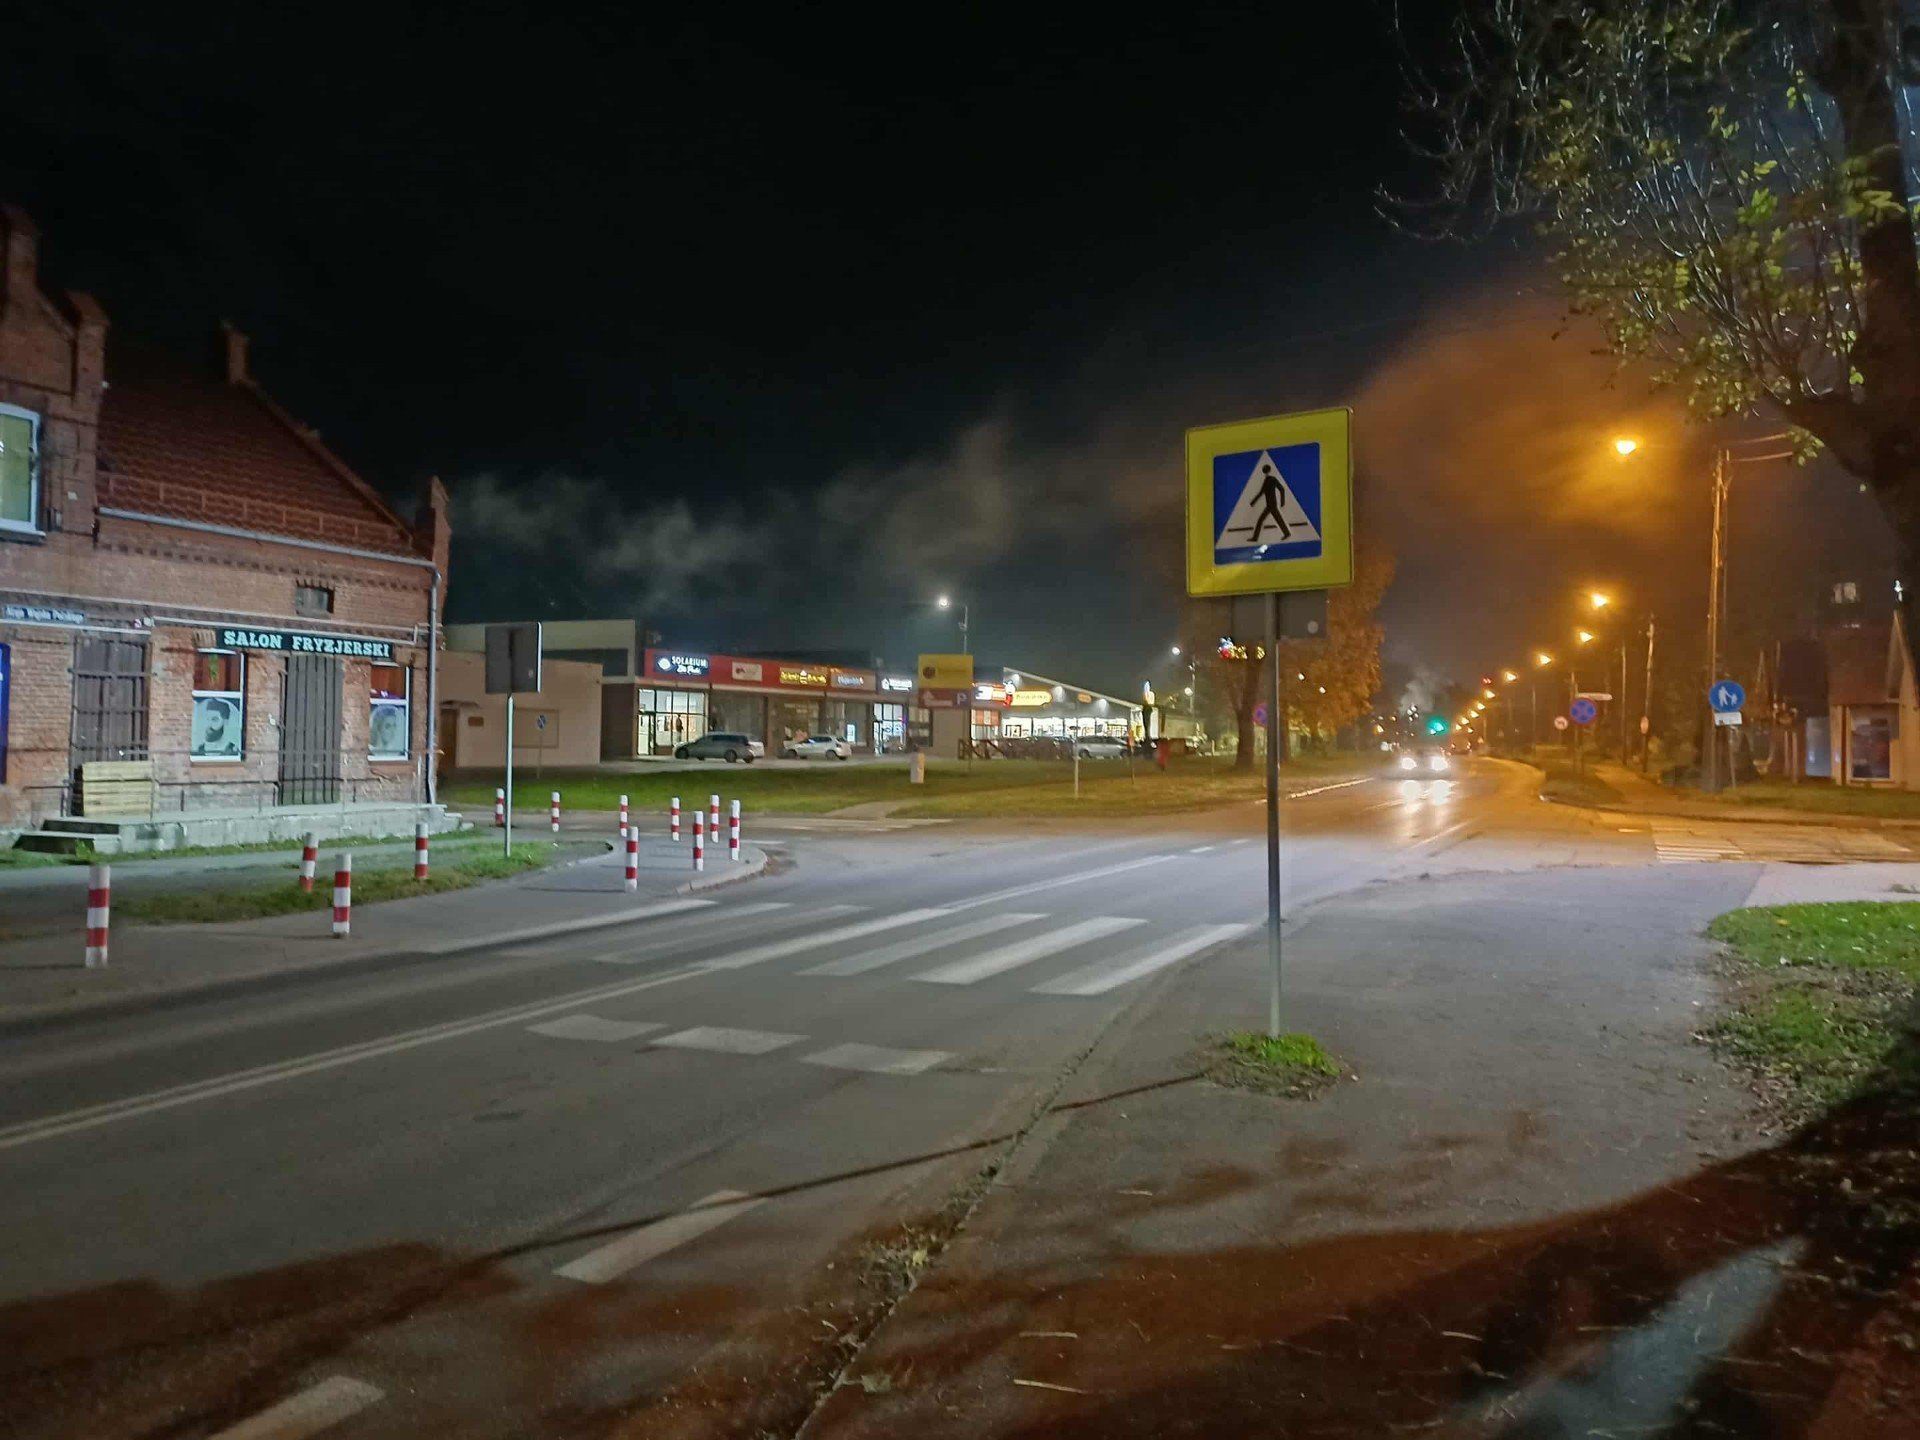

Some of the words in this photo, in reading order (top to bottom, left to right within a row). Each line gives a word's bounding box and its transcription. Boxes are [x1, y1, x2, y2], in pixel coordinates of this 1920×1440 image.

[223, 630, 283, 649] SALON
[292, 635, 390, 657] FRYZJERSKI
[671, 655, 708, 668] SOLARIUM
